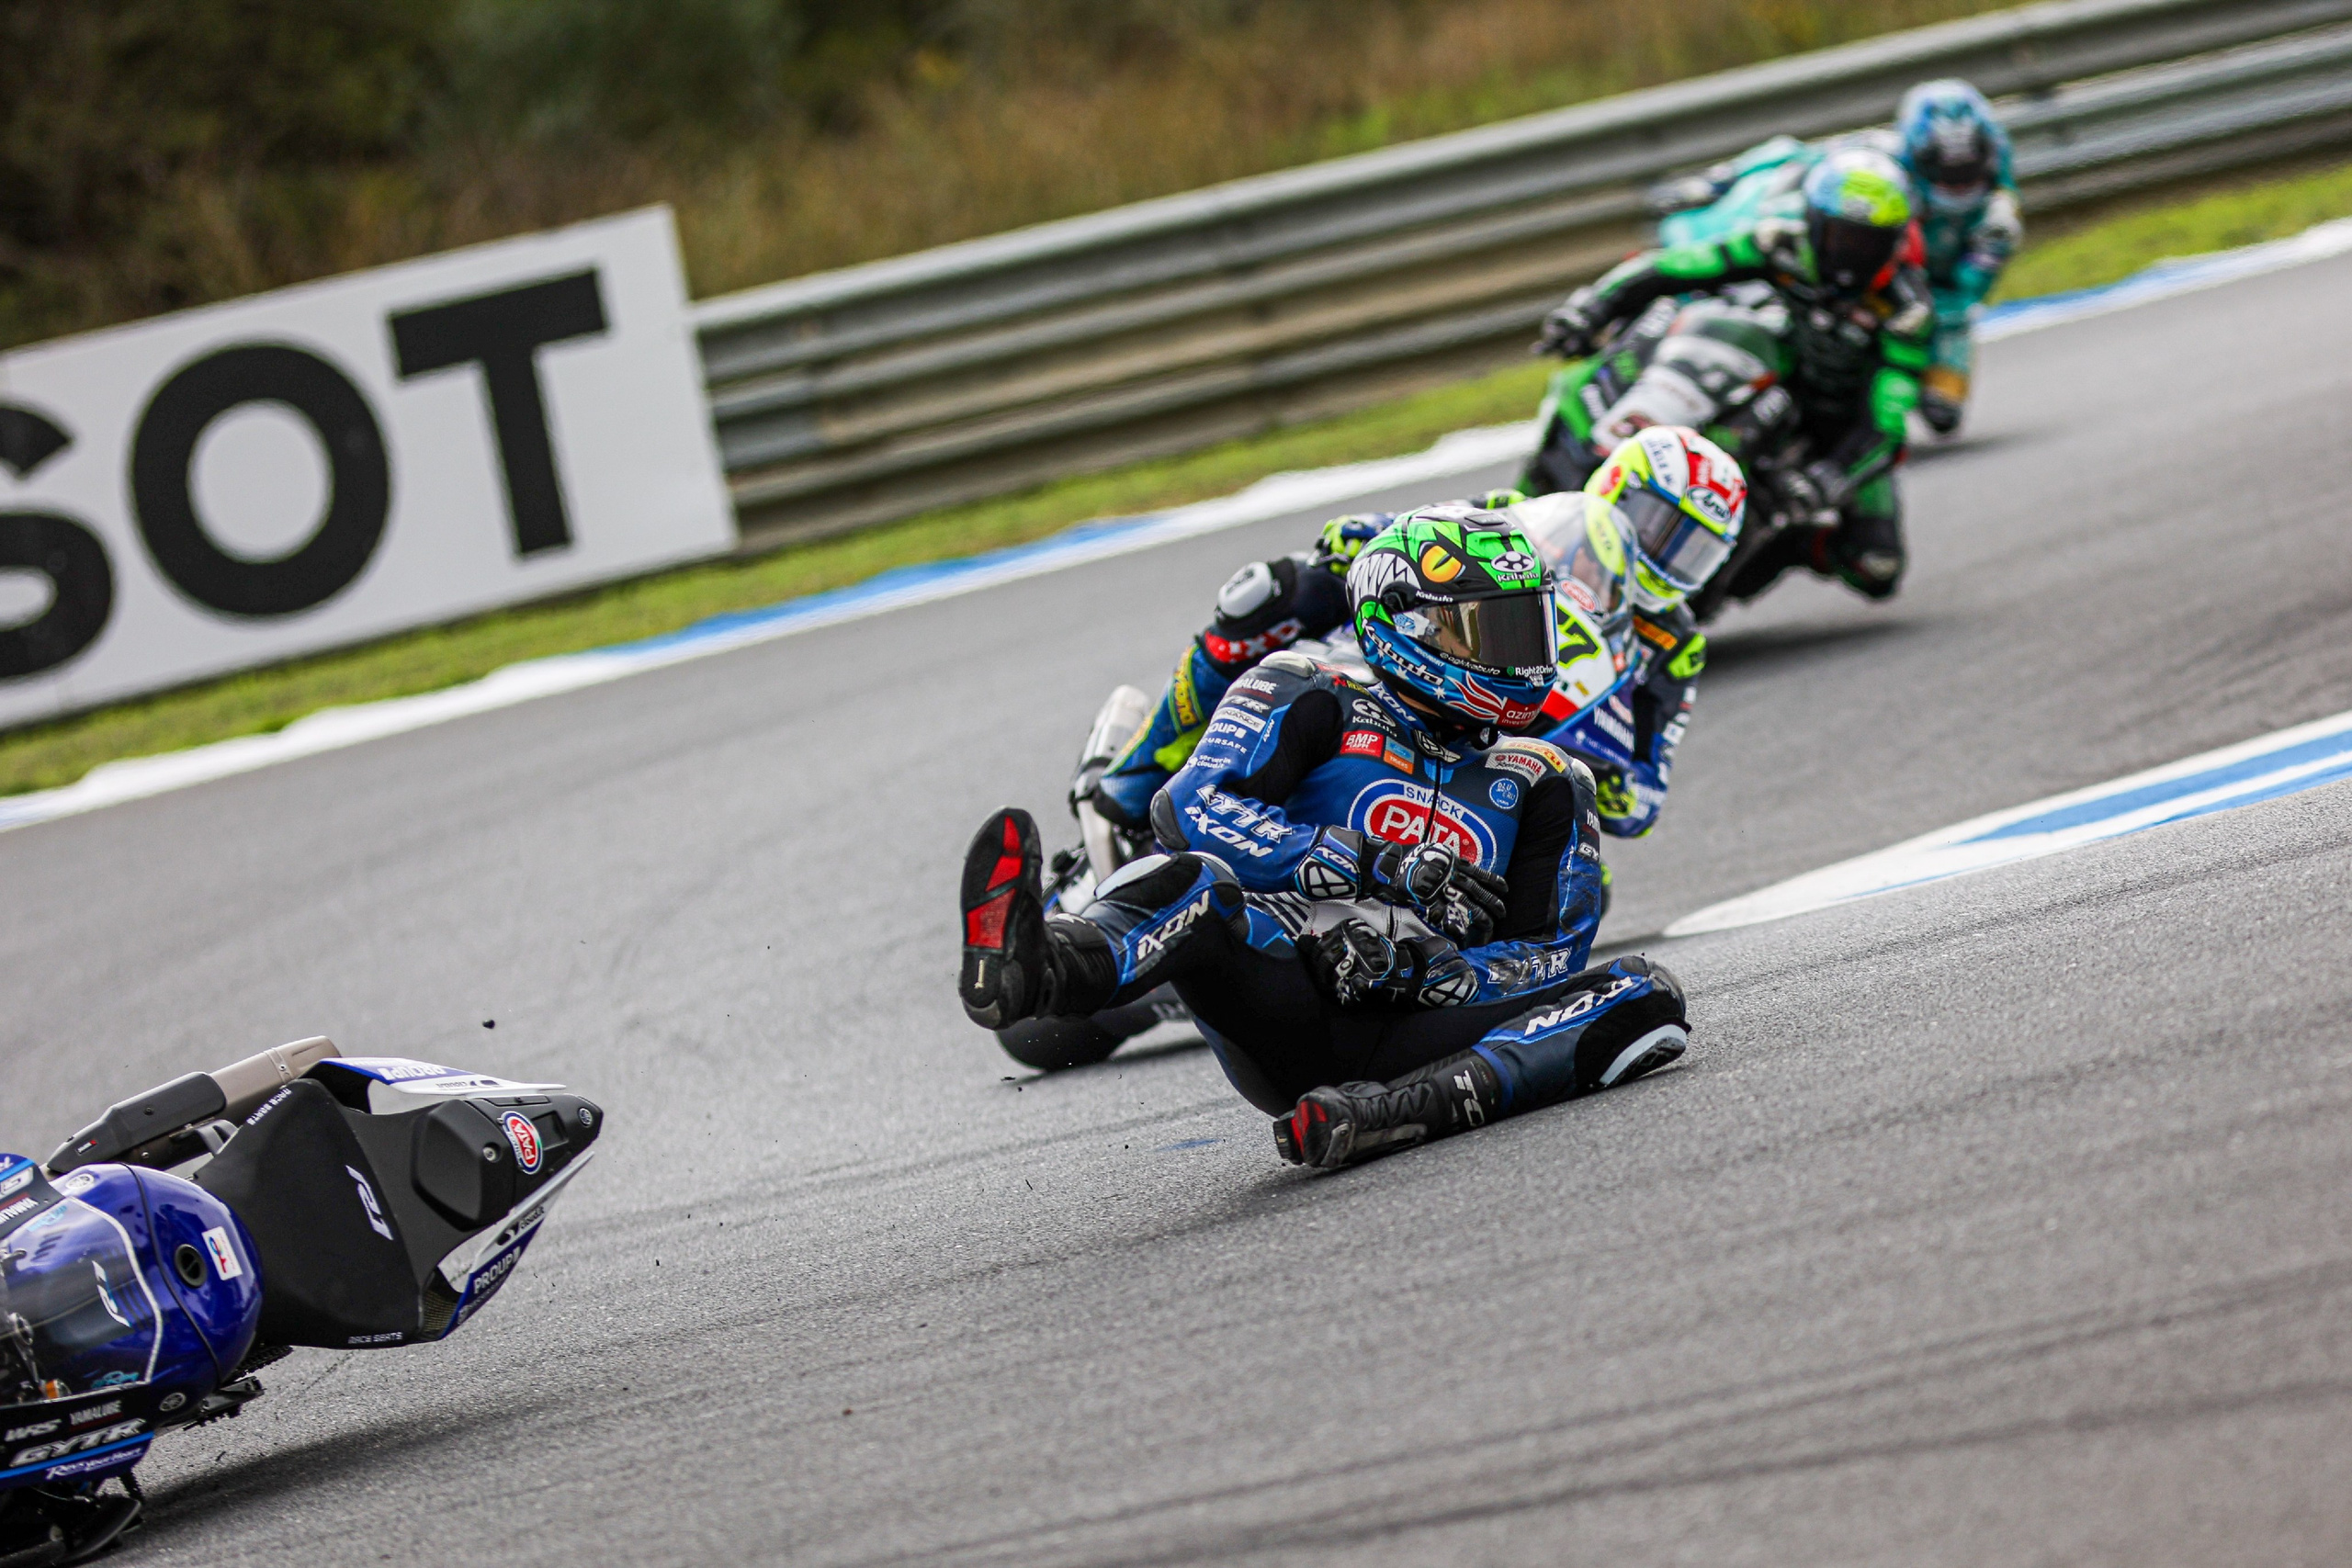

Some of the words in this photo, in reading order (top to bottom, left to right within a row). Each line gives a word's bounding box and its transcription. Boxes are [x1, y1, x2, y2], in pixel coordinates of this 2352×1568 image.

[1362, 618, 1444, 686] Kabuto
[1346, 733, 1379, 746] BMP
[1508, 754, 1543, 775] YAMAHA
[1406, 786, 1461, 819] SNACK
[1380, 805, 1461, 860] PATA
[514, 1122, 536, 1161] PATA
[9, 1417, 147, 1468] GYTR
